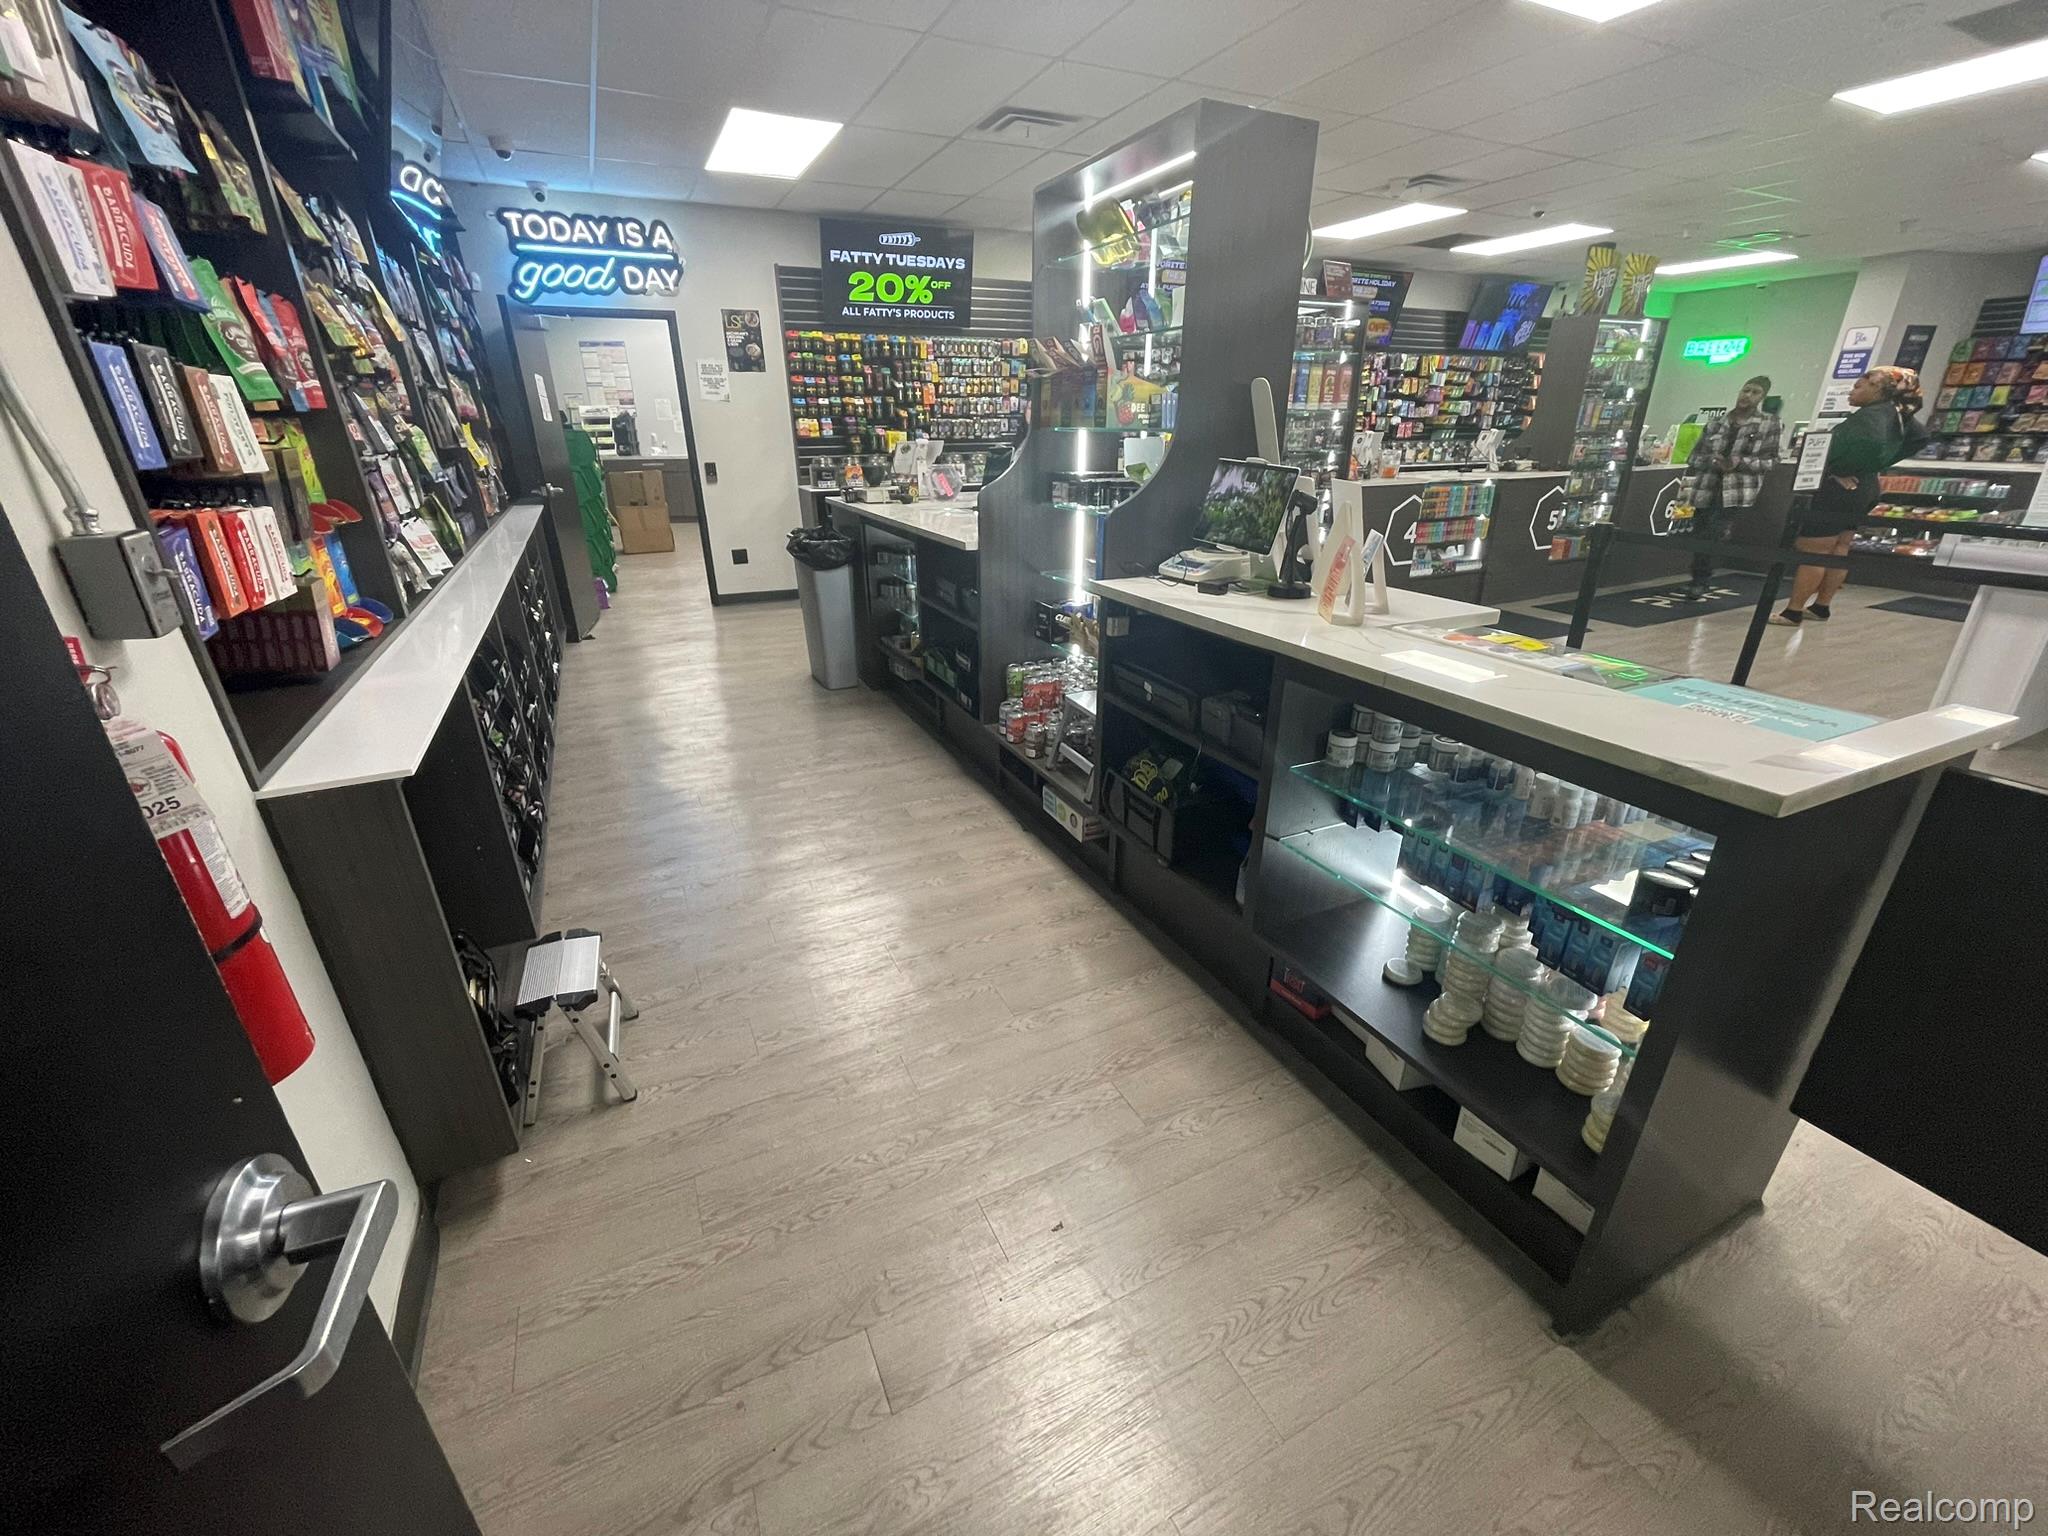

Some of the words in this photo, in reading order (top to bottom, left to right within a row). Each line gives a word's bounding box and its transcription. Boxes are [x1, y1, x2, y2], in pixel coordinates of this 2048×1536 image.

[101, 186, 135, 269] BARRACUDA
[503, 211, 608, 245] TODAY
[618, 222, 644, 248] IS
[652, 224, 673, 250] A
[515, 256, 616, 300] good
[623, 266, 679, 291] DAY
[829, 249, 884, 265] FATTY
[885, 253, 966, 270] TUESDAYS
[847, 271, 934, 305] 20%
[930, 280, 952, 290] OFF
[841, 306, 863, 316] ALL
[864, 307, 902, 318] FATTY'S
[904, 309, 956, 320] PRODUCTS
[114, 364, 151, 449] BARRACUDA
[156, 363, 188, 441] BARRACUDA
[1403, 521, 1418, 544] 4
[241, 529, 265, 592] BARRACUDA
[178, 551, 205, 623] BARRACUDA
